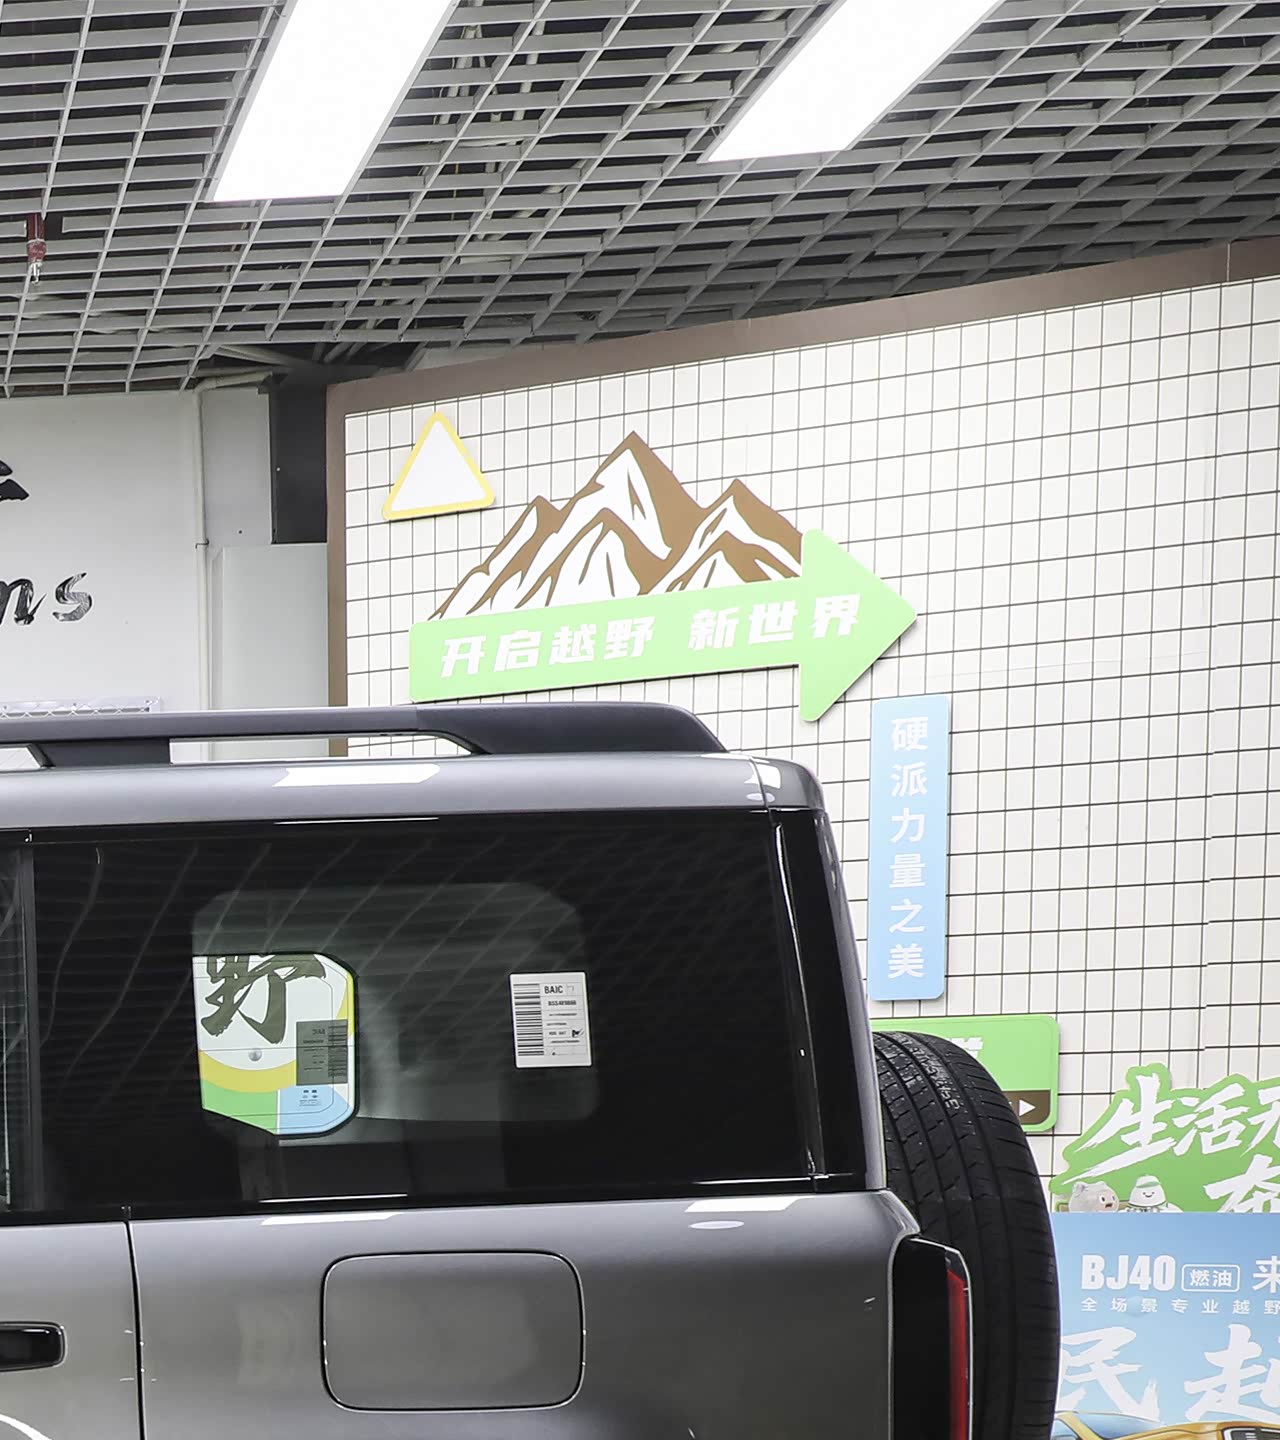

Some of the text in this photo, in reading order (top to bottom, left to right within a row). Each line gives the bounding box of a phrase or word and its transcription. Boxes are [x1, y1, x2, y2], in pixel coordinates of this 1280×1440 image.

[440, 594, 862, 678] 开启越野 新世界
[888, 716, 929, 979] 硬派力量之美
[544, 985, 563, 994] BAIC
[1081, 1255, 1176, 1292] BJ40
[1189, 1269, 1232, 1288] 燃油
